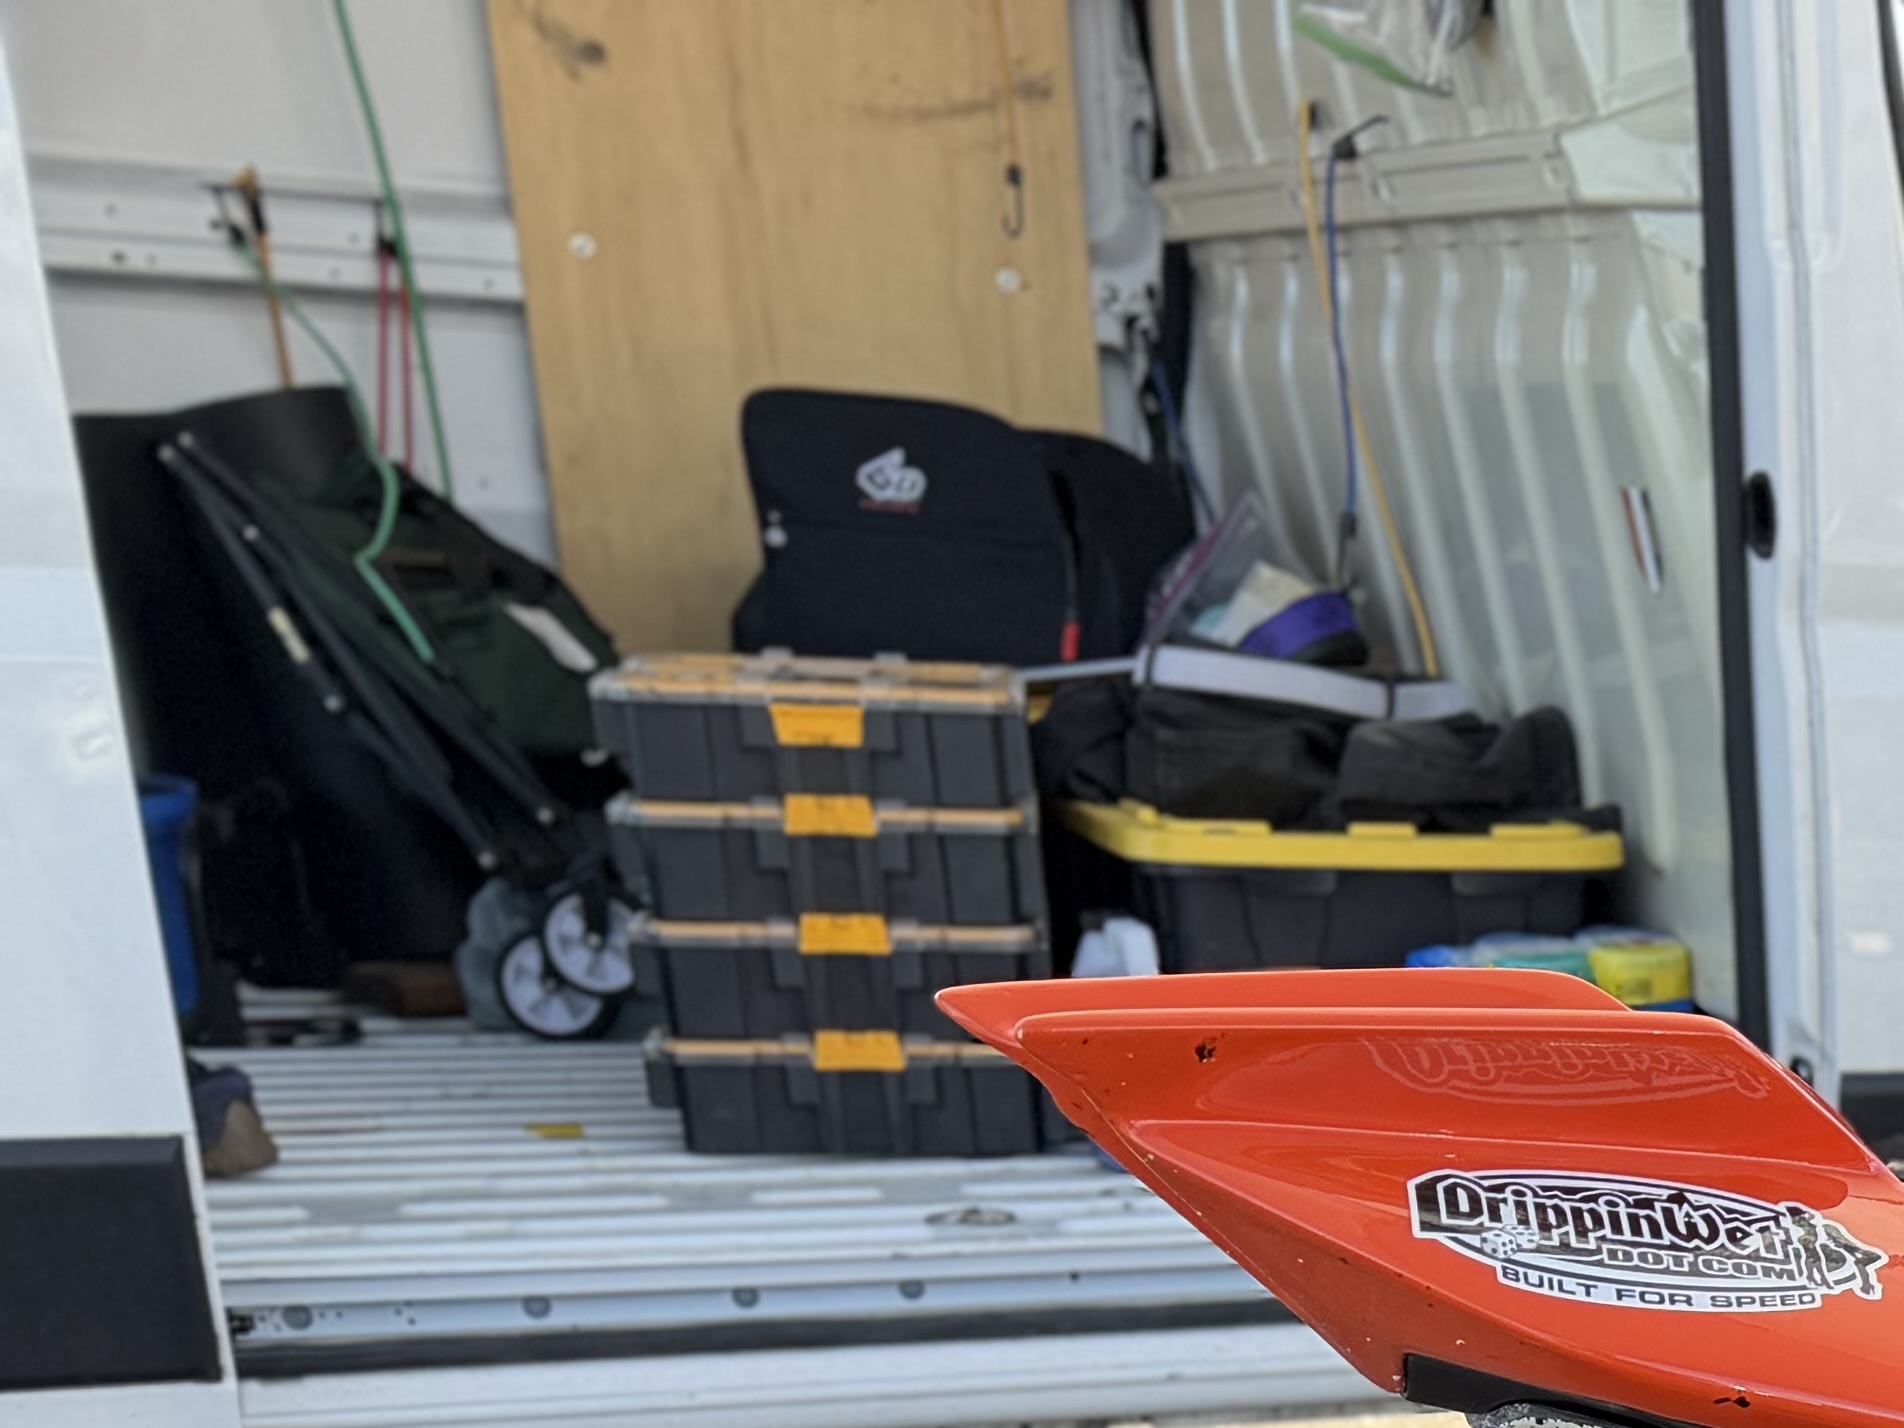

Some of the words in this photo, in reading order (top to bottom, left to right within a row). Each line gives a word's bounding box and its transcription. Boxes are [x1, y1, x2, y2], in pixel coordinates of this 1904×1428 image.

[1602, 1246, 1695, 1274] DOT
[1699, 1255, 1797, 1281] COM
[1501, 1265, 1596, 1298] BUILT
[1615, 1287, 1694, 1307] FOR
[1709, 1291, 1817, 1309] SPEED
